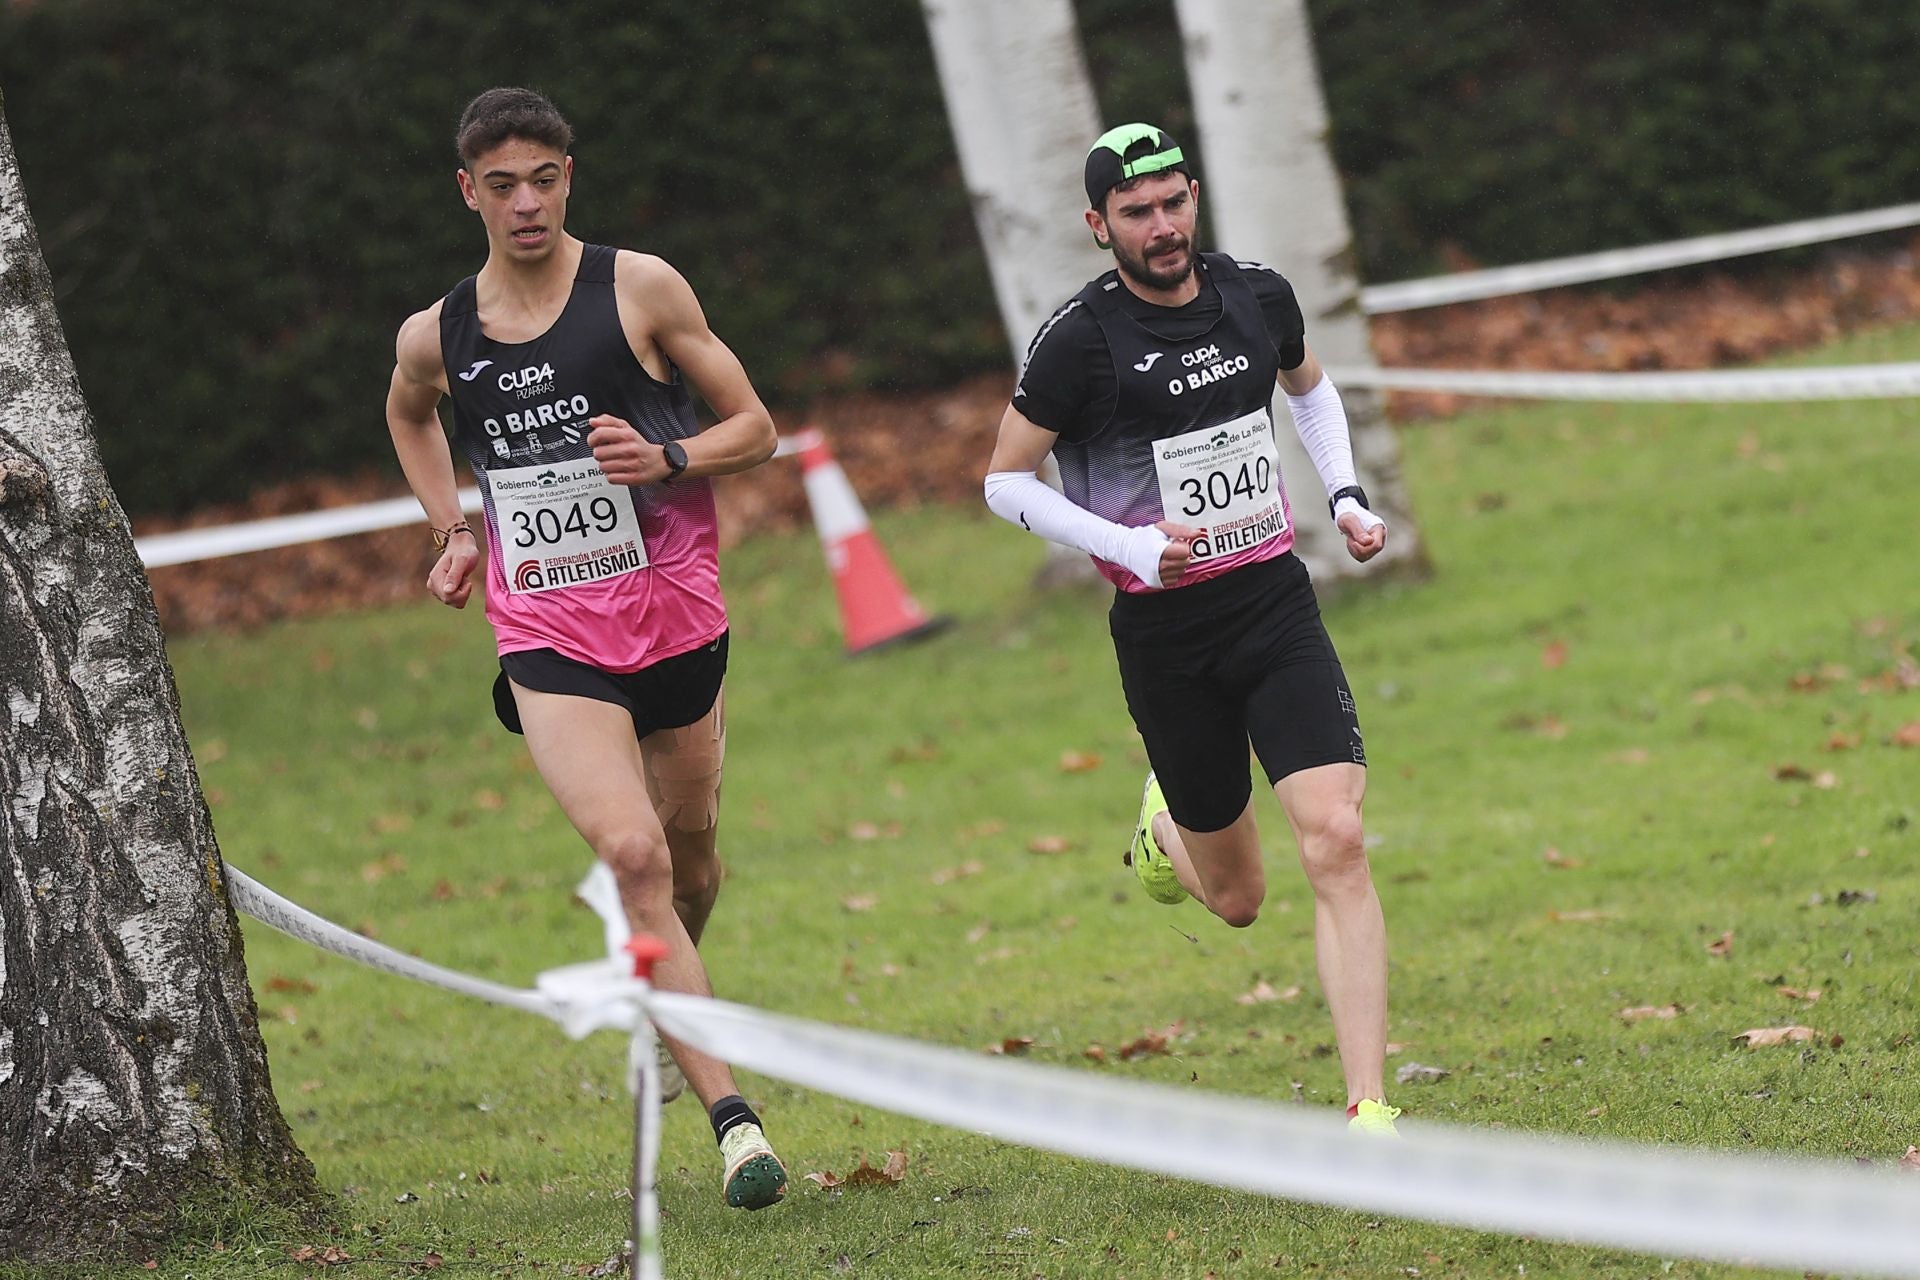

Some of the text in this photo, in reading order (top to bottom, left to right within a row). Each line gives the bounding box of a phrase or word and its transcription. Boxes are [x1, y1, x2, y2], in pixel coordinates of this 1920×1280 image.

[1181, 344, 1220, 367] CUPA
[498, 362, 555, 391] CUPA
[1168, 355, 1249, 395] O BARCO
[516, 381, 555, 400] PIZARRAS
[484, 395, 589, 437] O BARCO
[1162, 443, 1211, 460] Gobierno
[1229, 434, 1240, 443] de
[1241, 430, 1252, 439] La
[1218, 447, 1245, 459] Educación
[496, 480, 538, 490] Gobierno
[557, 474, 571, 484] de
[573, 472, 586, 480] La
[546, 487, 576, 498] Educación
[1179, 456, 1270, 516] 3040
[512, 497, 617, 548] 3049
[1213, 514, 1255, 535] FEDERACIÓN
[1215, 511, 1284, 554] ATLETISMO
[545, 540, 635, 568] FEDERACIÓN RIOJANA DE
[547, 549, 641, 586] ATLETISMO
